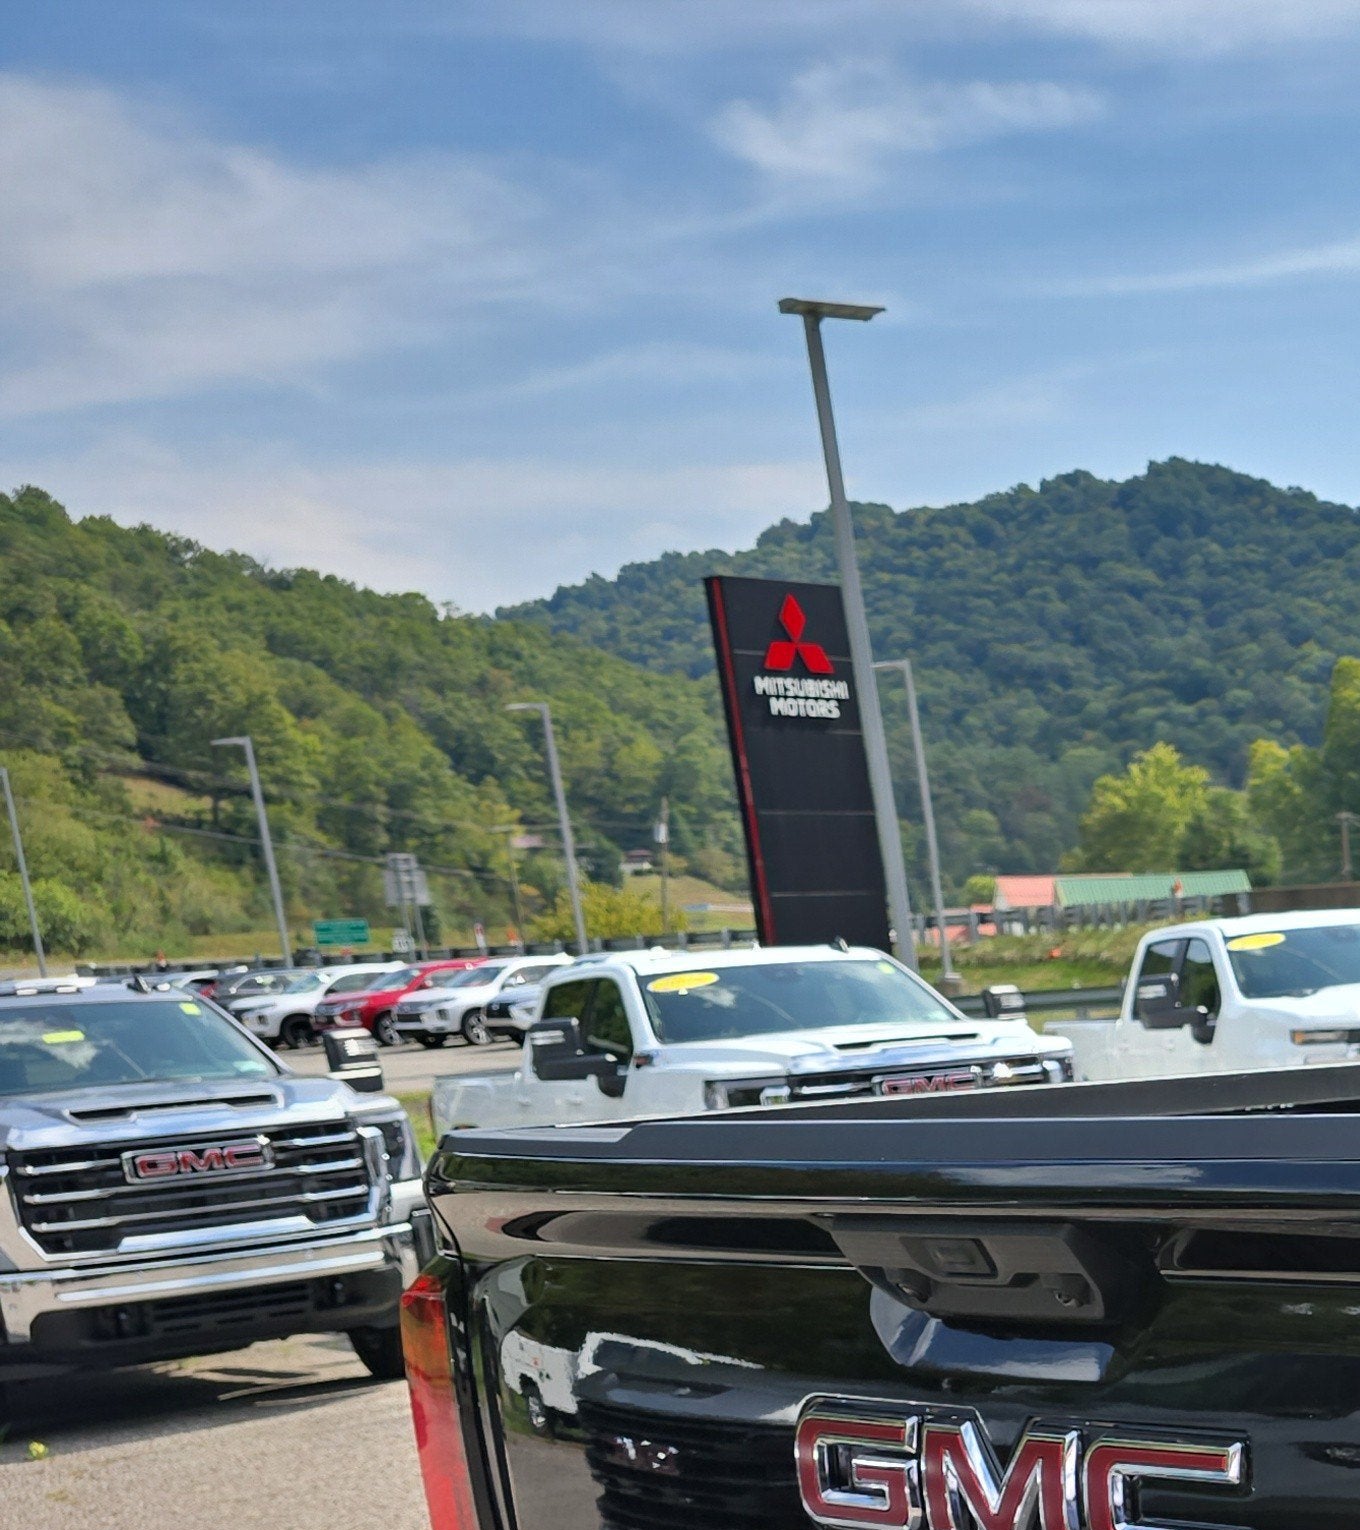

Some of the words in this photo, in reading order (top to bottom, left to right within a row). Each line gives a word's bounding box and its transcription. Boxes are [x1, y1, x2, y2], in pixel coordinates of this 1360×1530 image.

[754, 676, 849, 699] MITSUBISHI
[769, 697, 840, 719] MOTORS
[134, 1143, 264, 1179] GMC
